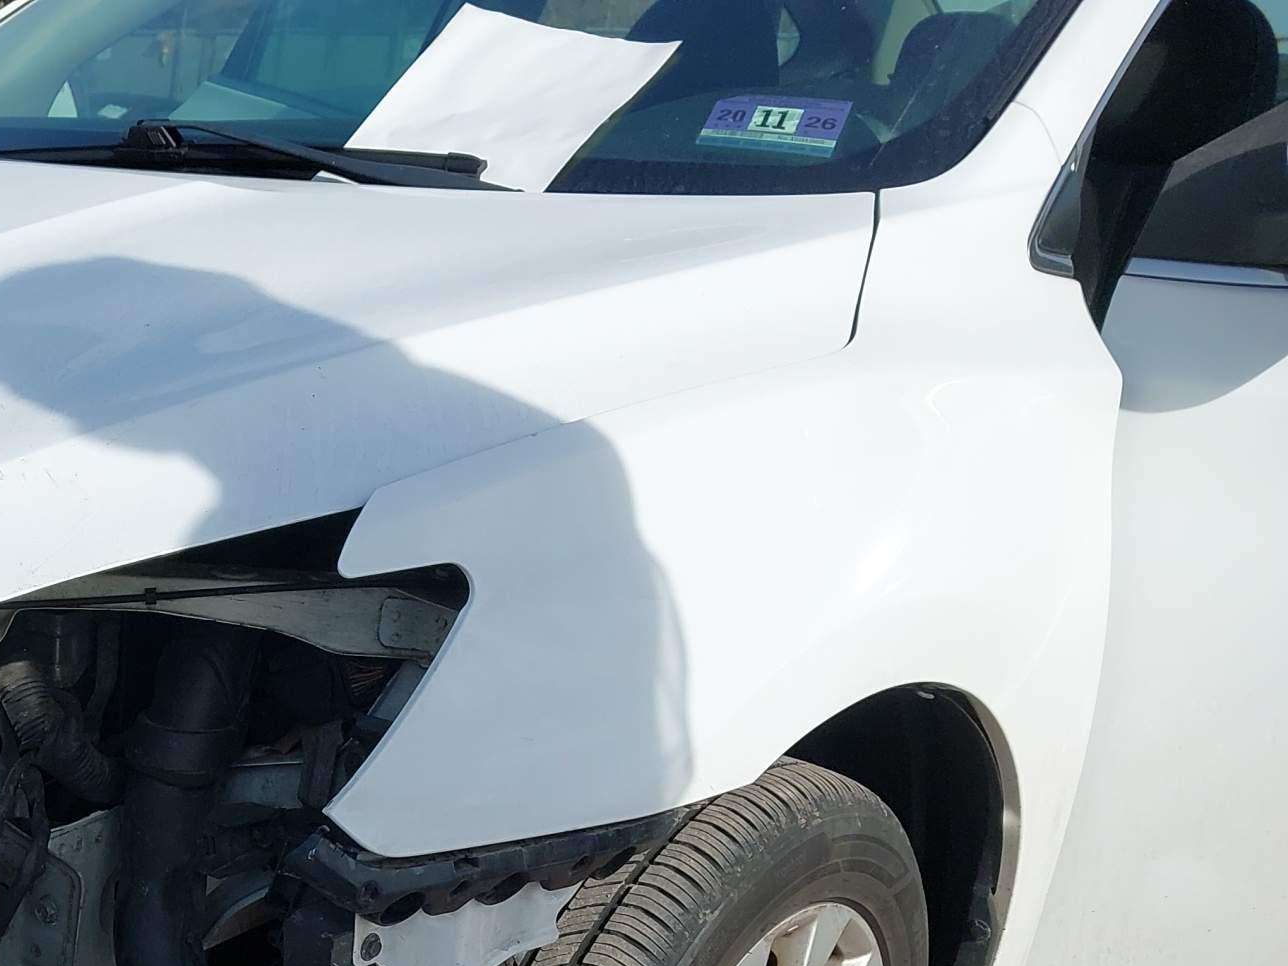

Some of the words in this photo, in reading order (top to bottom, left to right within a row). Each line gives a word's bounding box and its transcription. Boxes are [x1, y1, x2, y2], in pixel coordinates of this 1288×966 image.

[717, 109, 747, 121] 20
[755, 110, 789, 130] 11
[803, 115, 837, 130] 26
